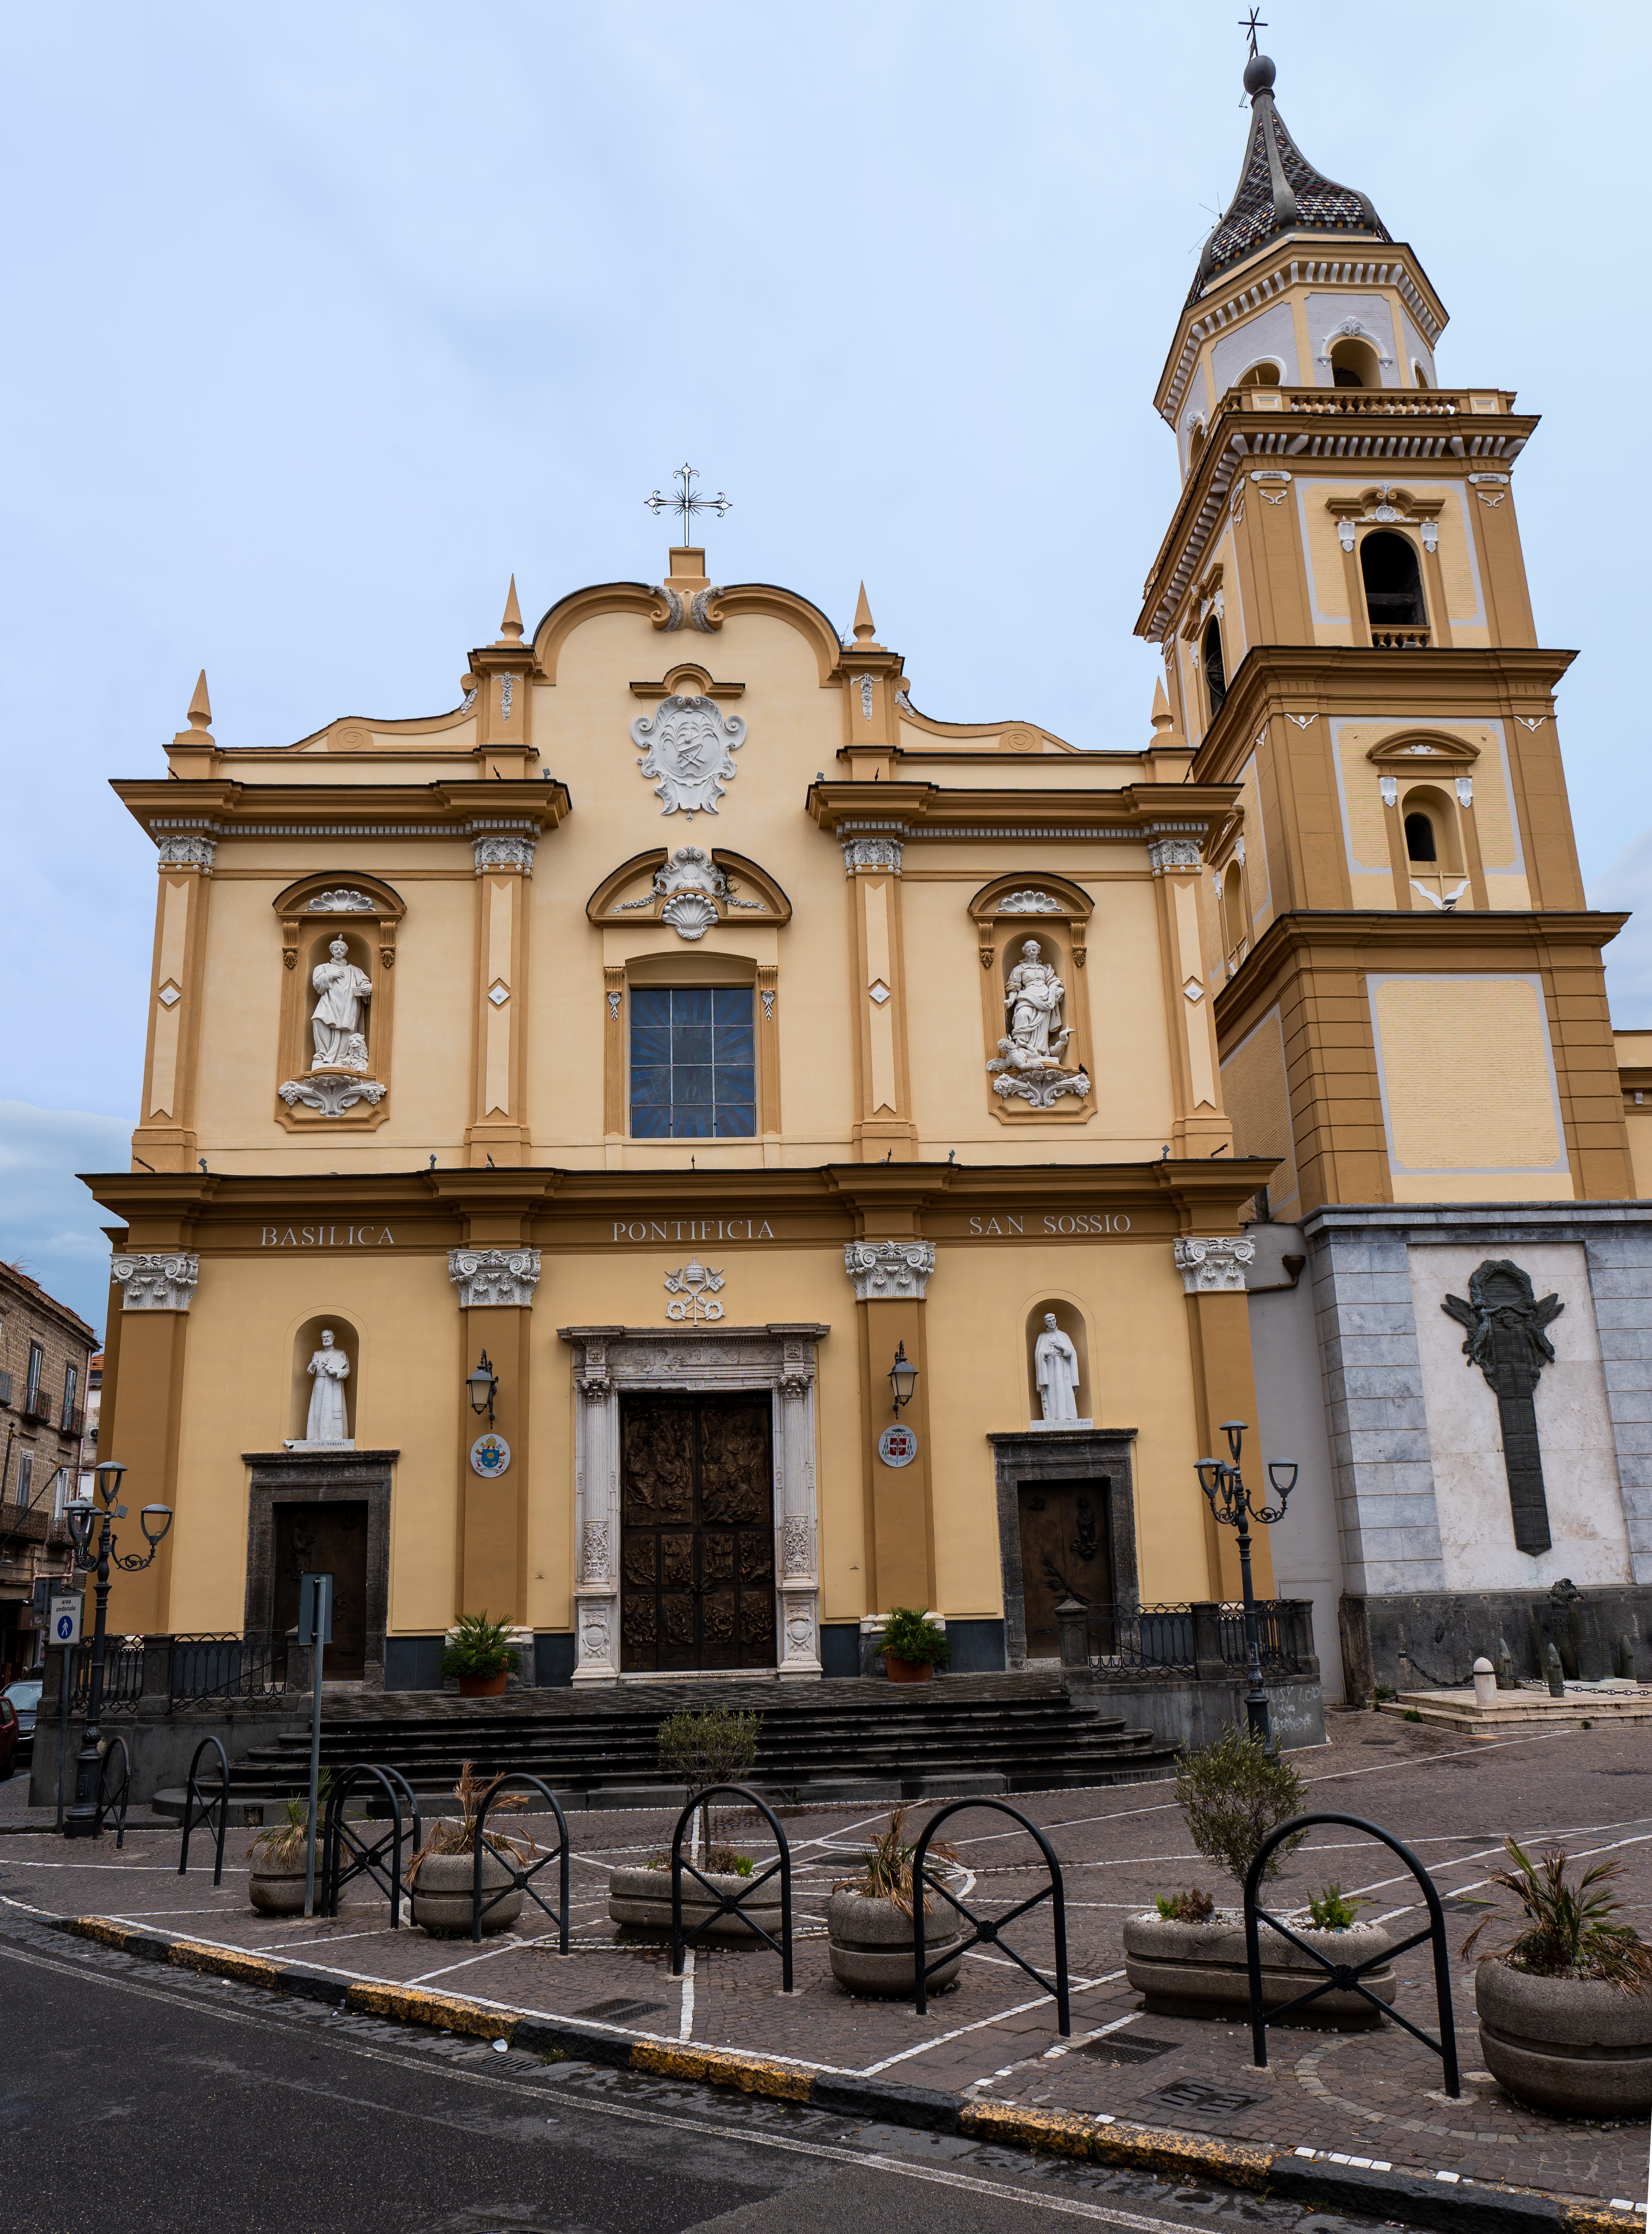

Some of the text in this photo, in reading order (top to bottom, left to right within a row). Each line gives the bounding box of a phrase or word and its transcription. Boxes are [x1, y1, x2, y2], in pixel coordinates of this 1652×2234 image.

[612, 1220, 775, 1241] PONTIFICIA
[969, 1214, 1131, 1234] SAN SOSSIO
[261, 1226, 394, 1245] BASILICA
